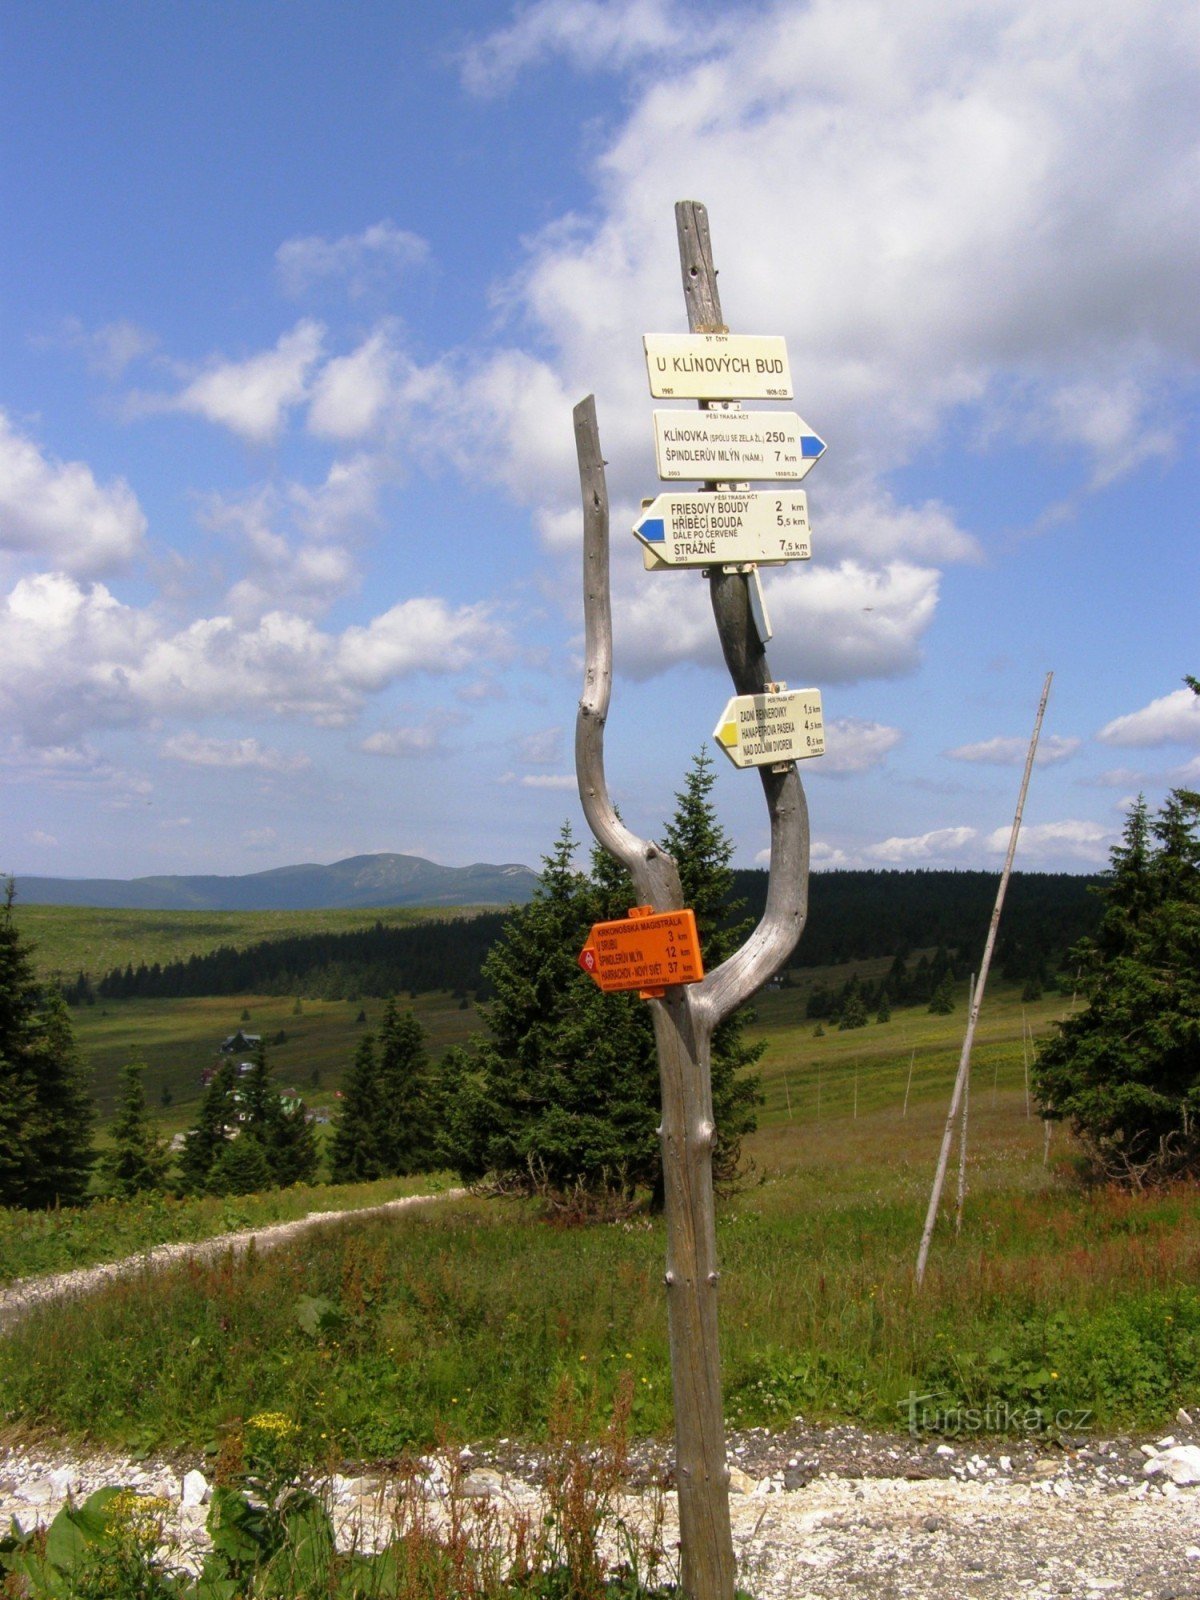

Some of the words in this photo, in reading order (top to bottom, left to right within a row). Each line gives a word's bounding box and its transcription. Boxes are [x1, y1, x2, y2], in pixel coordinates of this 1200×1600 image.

[656, 357, 666, 372] U
[673, 353, 750, 373] KLÍNOVÝCH
[756, 358, 783, 374] BUD
[664, 428, 708, 442] KLÍNOVKA
[766, 432, 786, 443] 250
[666, 448, 717, 462] ŠPINDLERŮV
[718, 448, 740, 461] MLÝN
[742, 454, 764, 463] (NÁM.)
[774, 451, 781, 461] 7
[784, 454, 797, 462] km
[671, 502, 715, 515] FRIESOVY
[717, 502, 749, 513] BOUDY
[775, 501, 782, 512] 2
[672, 515, 709, 530] HŘÍBĚCÍ
[711, 516, 744, 528] BOUDA
[776, 516, 791, 528] 5,5
[793, 518, 806, 526] km
[673, 530, 692, 540] DÁLE
[694, 531, 704, 539] PO
[705, 528, 738, 538] ČERVENÉ
[674, 540, 716, 555] STRÁŽNÉ
[779, 540, 793, 552] 7,5
[795, 542, 808, 550] km
[804, 704, 812, 714] 1,5
[777, 722, 794, 734] PASEKA
[804, 720, 813, 730] 4,5
[742, 743, 754, 756] NAD
[772, 738, 793, 752] DVOREM
[806, 736, 816, 746] 8,5
[598, 923, 640, 937] KRKONOŠSKÁ
[641, 916, 682, 931] MAGISTRÁLA
[668, 931, 674, 942] 3
[666, 946, 676, 958] 12
[680, 948, 690, 956] km
[668, 962, 678, 974] 37
